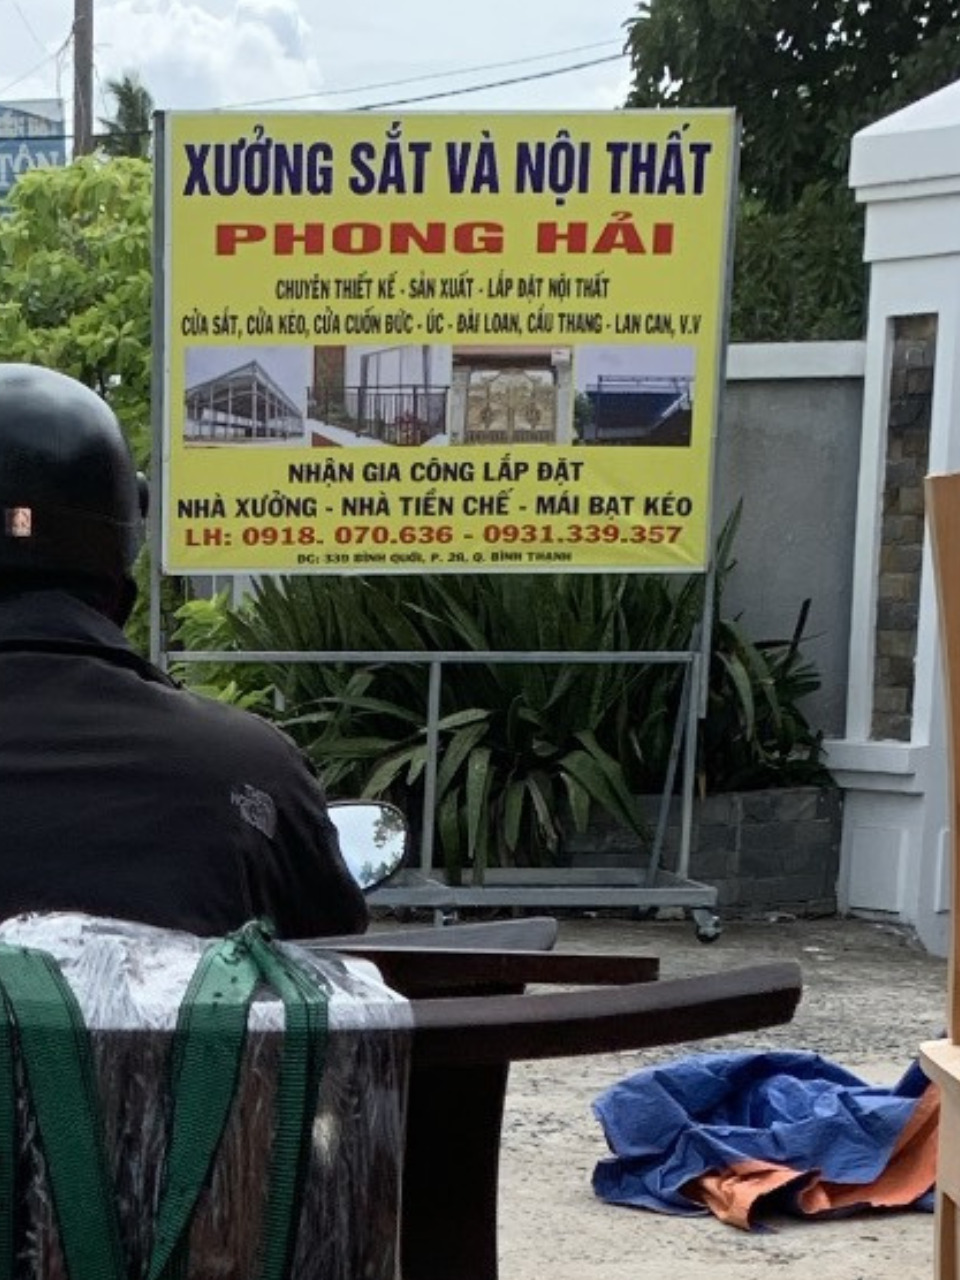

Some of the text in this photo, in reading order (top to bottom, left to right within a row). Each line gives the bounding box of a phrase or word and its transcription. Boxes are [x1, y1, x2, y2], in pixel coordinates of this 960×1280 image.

[183, 121, 712, 206] XƯỞNG SẮT VÀ NỘI THẤT
[215, 210, 674, 256] PHONG HẢI
[275, 274, 331, 299] CHUYÊN
[335, 270, 373, 299] THIẾT
[408, 270, 436, 298] SẢN
[441, 270, 474, 298] XUẤT
[426, 307, 444, 335] ÚC
[558, 312, 603, 334] THANG
[615, 313, 640, 334] LAN
[288, 453, 584, 488] NHẬN GIA CÔNG LẮP ĐẶT
[177, 492, 226, 519] NHÀ
[235, 489, 318, 518] XƯỞNG
[341, 490, 390, 517] NHÀ
[463, 487, 514, 517] CHẾ
[535, 490, 580, 516] MÁI
[589, 496, 635, 521] BẠT
[643, 490, 693, 517] KÉO
[185, 527, 232, 547] LH:
[242, 526, 324, 546] 0918.
[334, 525, 454, 545] 070.636
[484, 524, 684, 545] 0931.339.357
